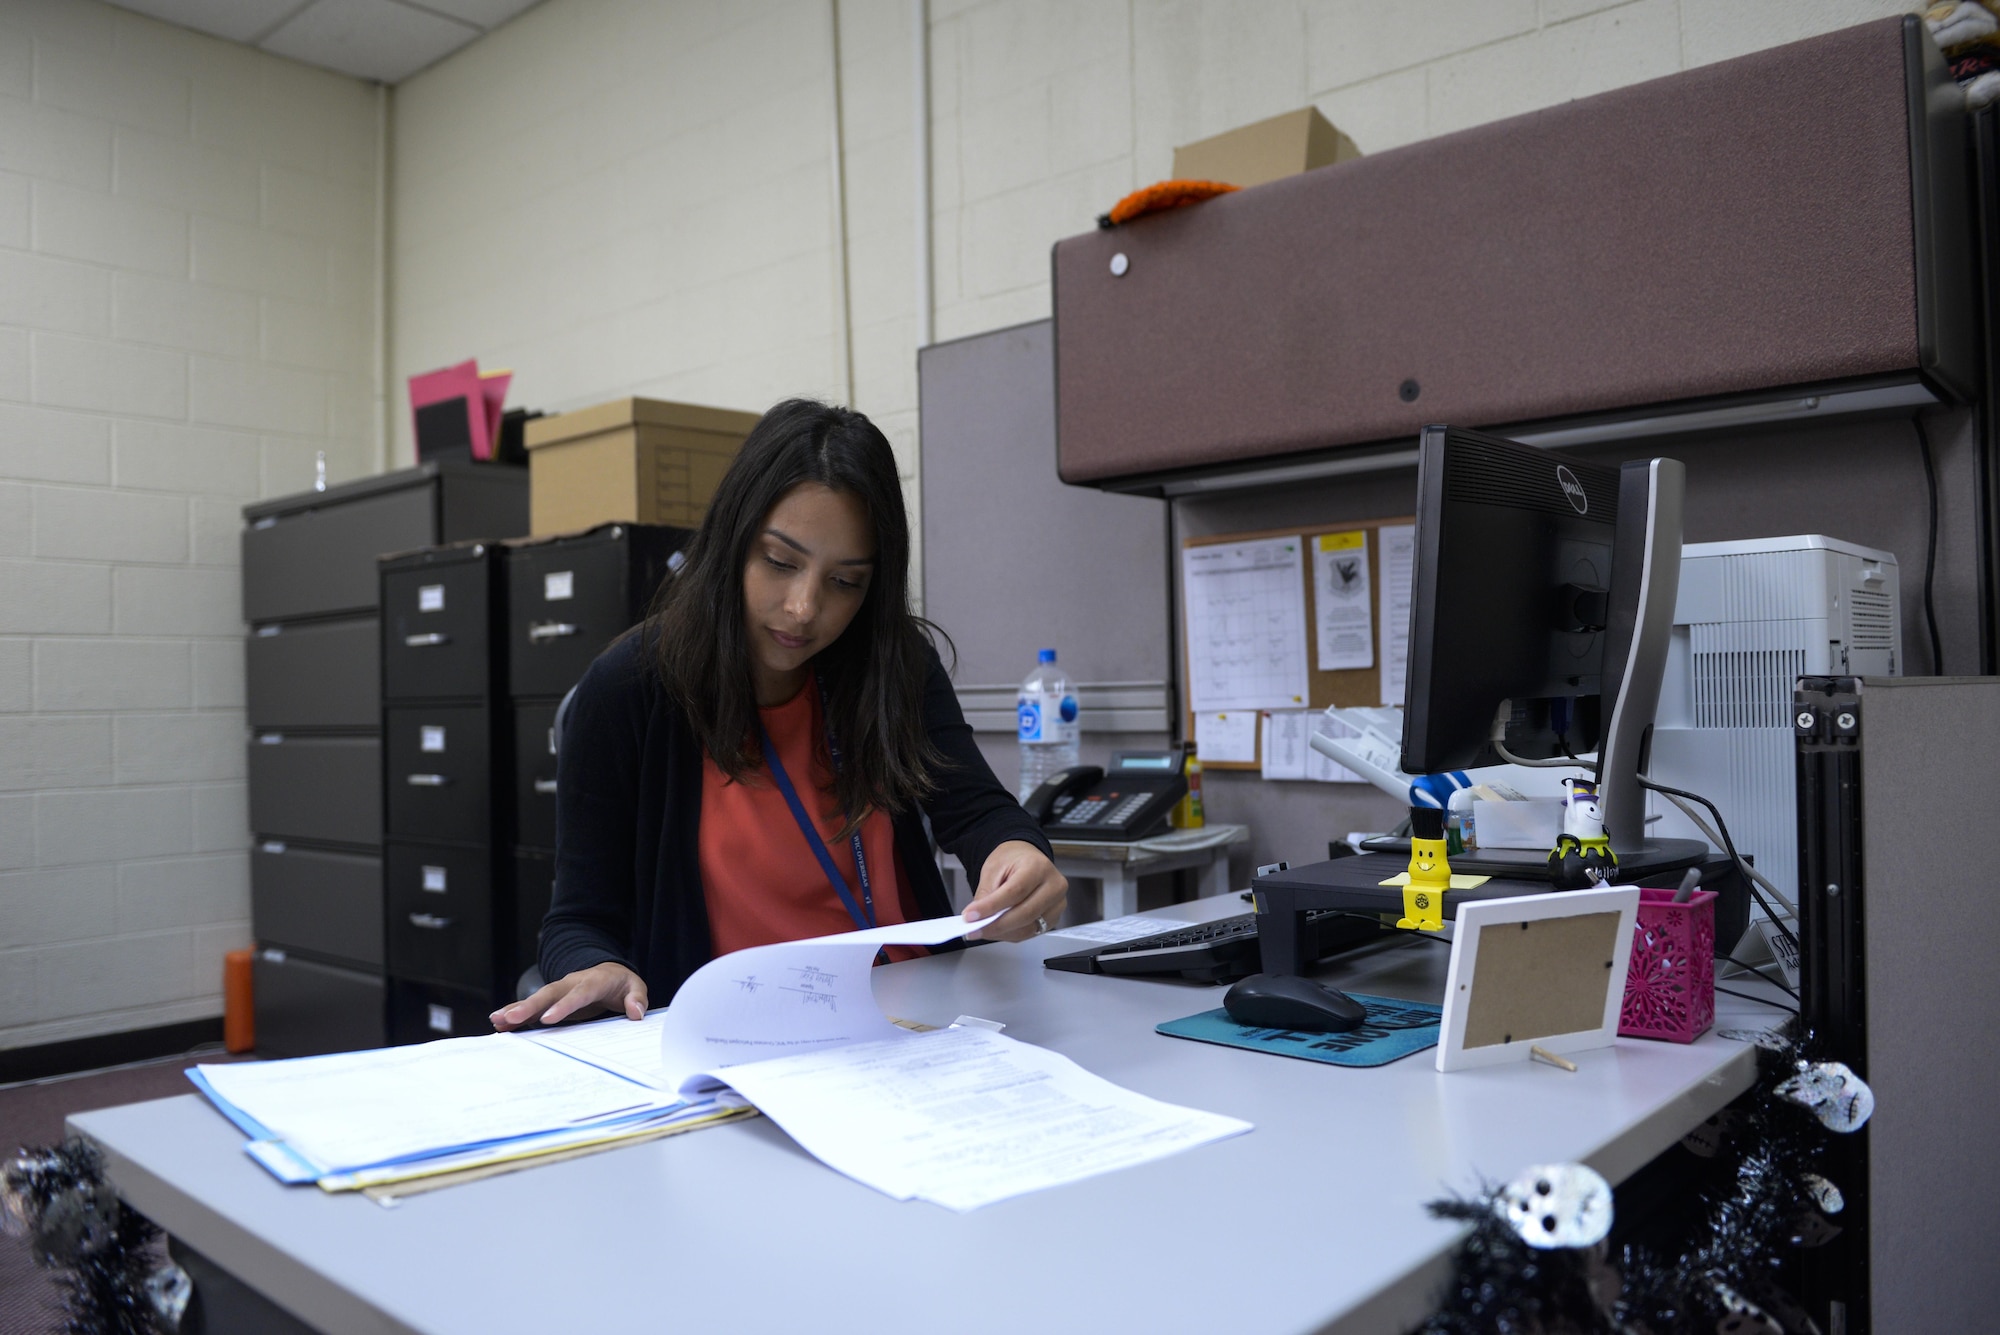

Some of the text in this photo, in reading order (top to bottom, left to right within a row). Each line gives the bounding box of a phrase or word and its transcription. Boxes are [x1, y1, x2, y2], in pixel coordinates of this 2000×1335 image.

[1562, 481, 1583, 496] DELL
[854, 835, 869, 887] WIC OVERSEAS
[1307, 1029, 1391, 1053] ONE
